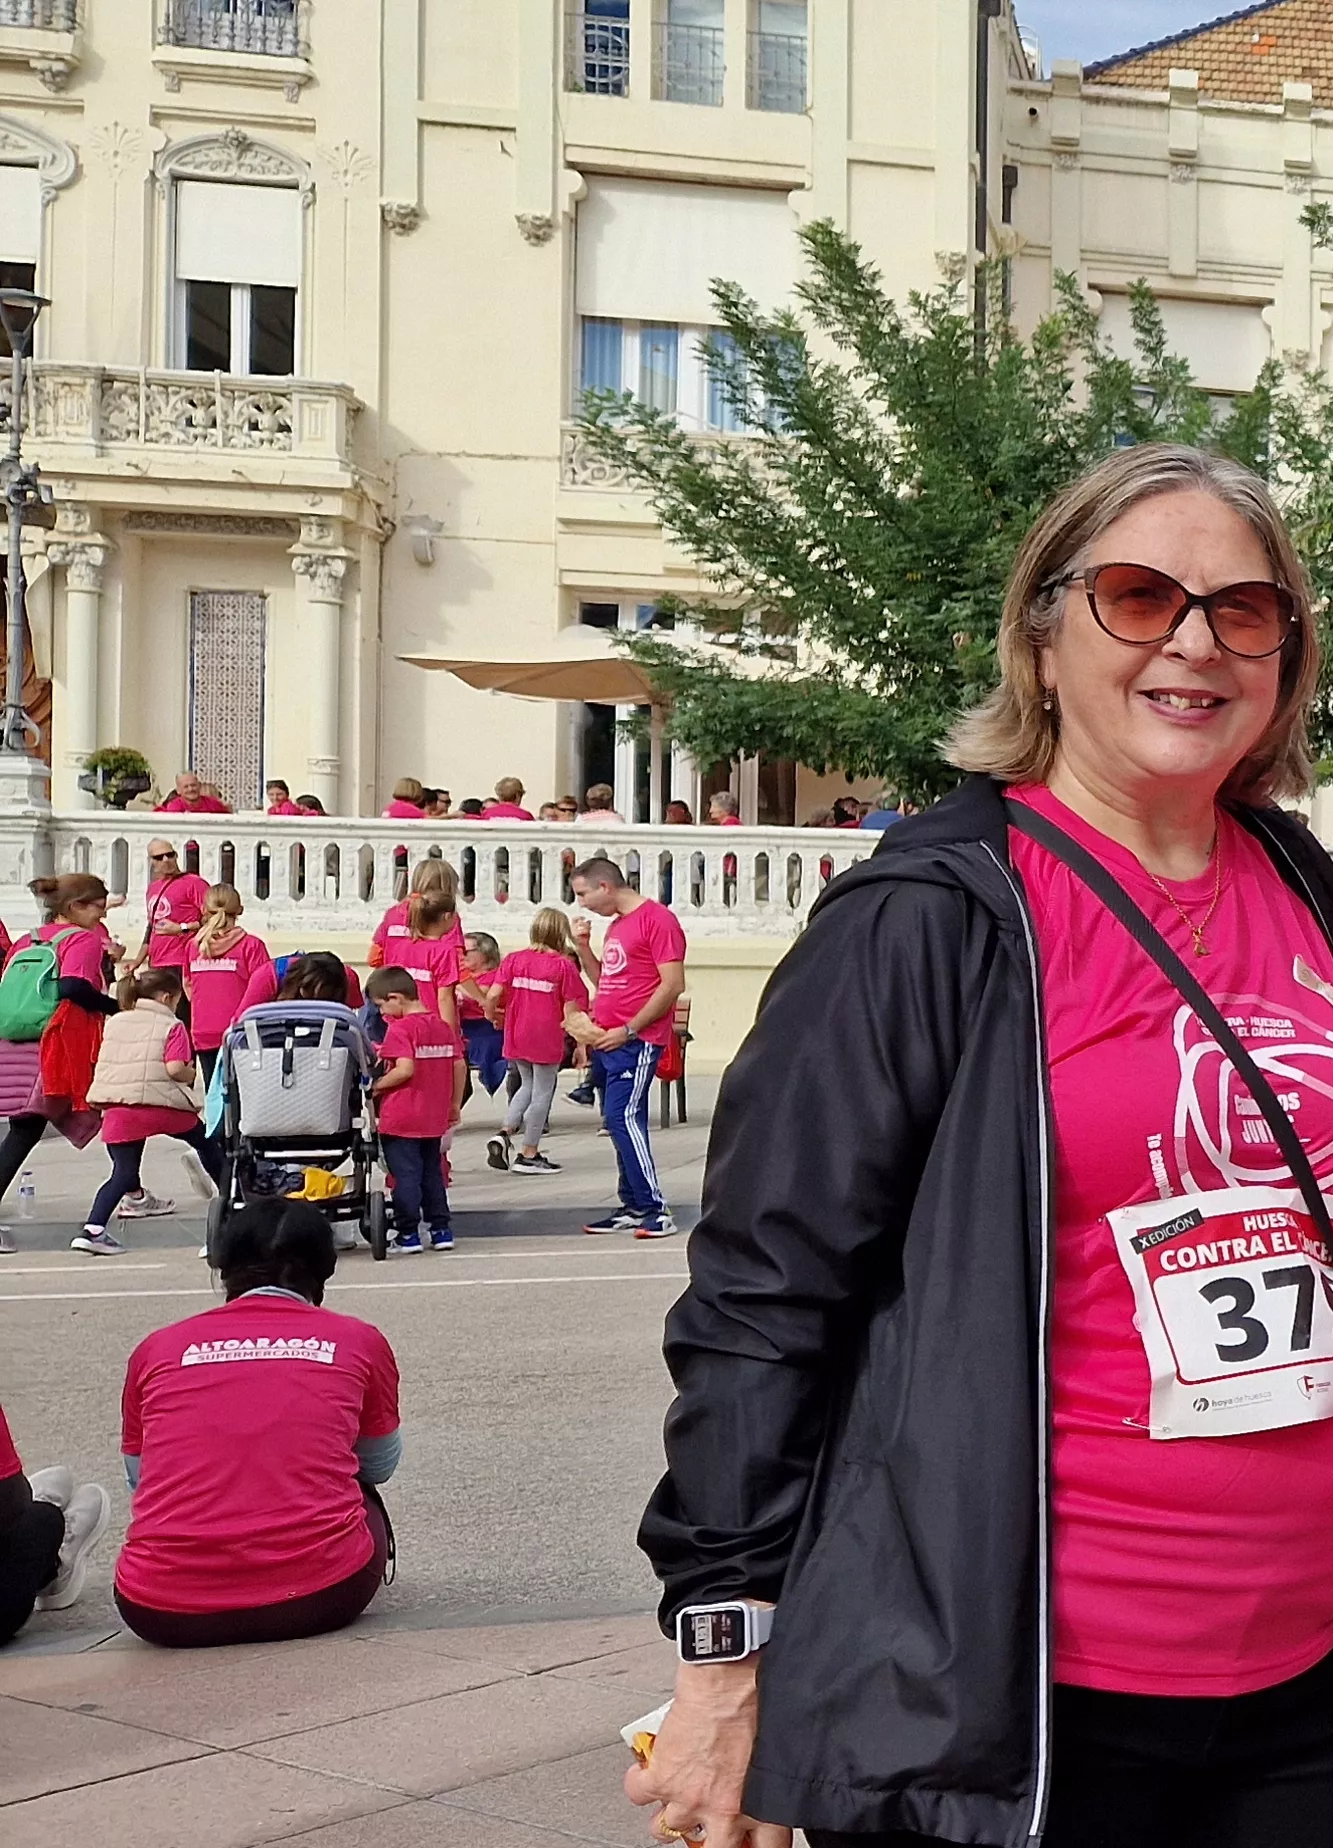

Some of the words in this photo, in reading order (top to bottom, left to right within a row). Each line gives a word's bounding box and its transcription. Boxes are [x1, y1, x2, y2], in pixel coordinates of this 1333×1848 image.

[1250, 1016, 1292, 1028] HUESCA
[1238, 1028, 1250, 1037] EL
[1148, 1215, 1195, 1246] EDICIÓN
[1160, 1237, 1266, 1272] CONTRA
[1271, 1231, 1298, 1253] EL
[184, 1336, 337, 1355] ALTOARAGÓN
[196, 1350, 319, 1361] SUPERMERCADOS
[1211, 1397, 1233, 1407] hoya
